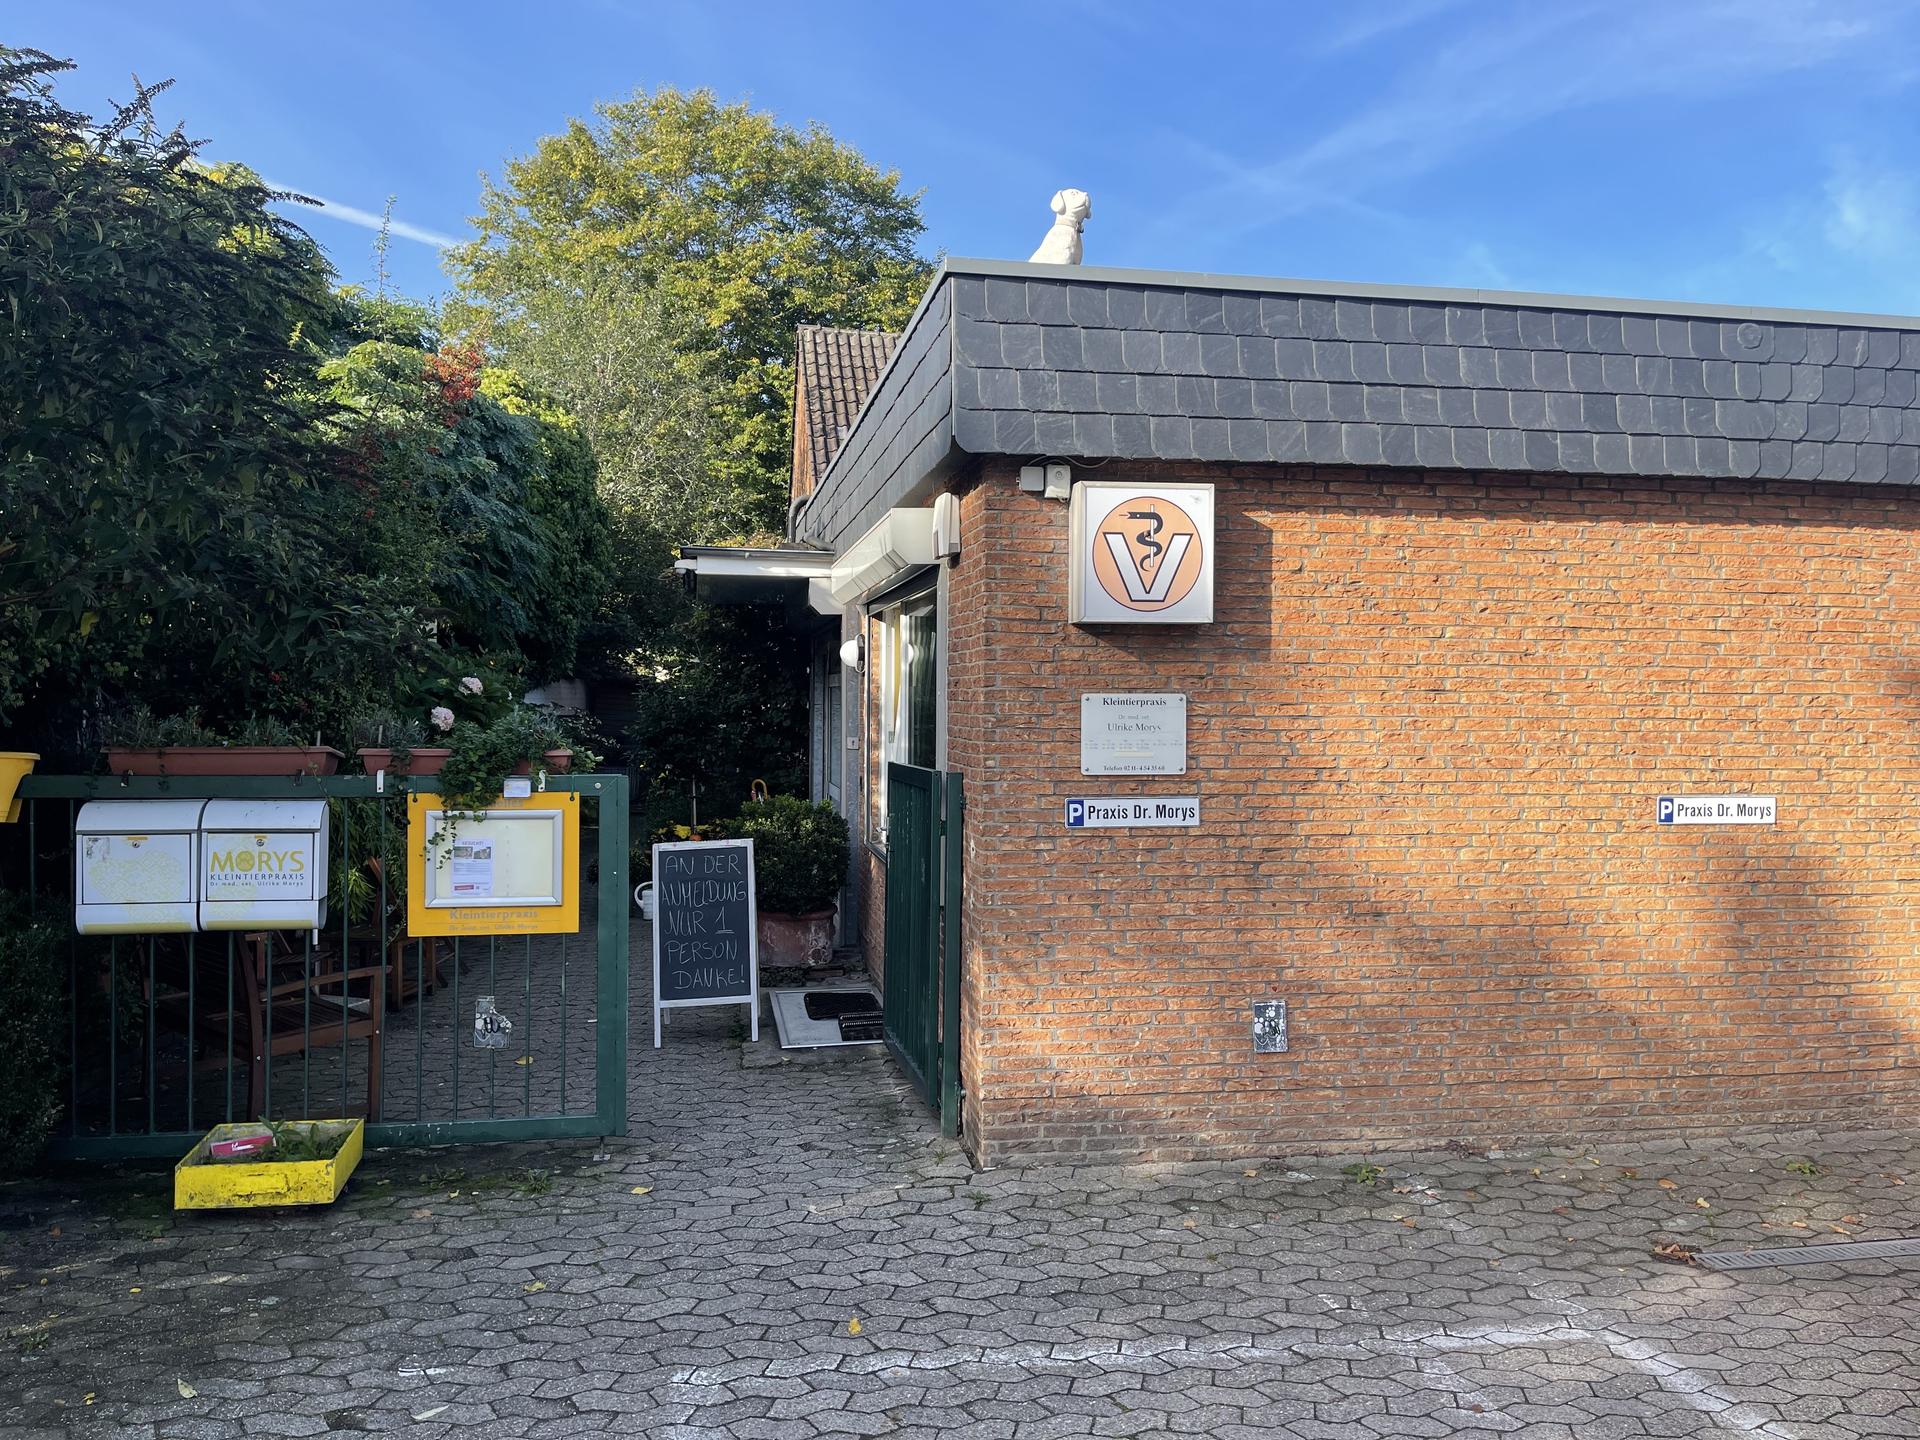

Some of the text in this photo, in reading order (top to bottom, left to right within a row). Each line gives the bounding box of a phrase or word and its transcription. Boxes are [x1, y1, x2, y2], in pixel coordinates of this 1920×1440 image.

[1102, 697, 1167, 707] Kleintierpraxis
[1107, 723, 1161, 733] Ulrike Morys
[1088, 805, 1128, 819] Praxis
[1134, 805, 1152, 819] Dr.
[1156, 804, 1195, 821] Morys
[1677, 803, 1713, 817] Praxis
[1717, 803, 1733, 817] Dr.
[1737, 803, 1772, 819] Morys
[210, 850, 304, 872] MORYS
[666, 854, 741, 875] AN DER
[210, 873, 304, 881] KLEINTIERPRAXIS
[661, 880, 746, 908] ANMELDUNG
[450, 909, 539, 920] Kleintierpraxis
[664, 906, 735, 936] NUR 1
[664, 939, 738, 965] PERSON
[672, 964, 745, 990] DANKE!
